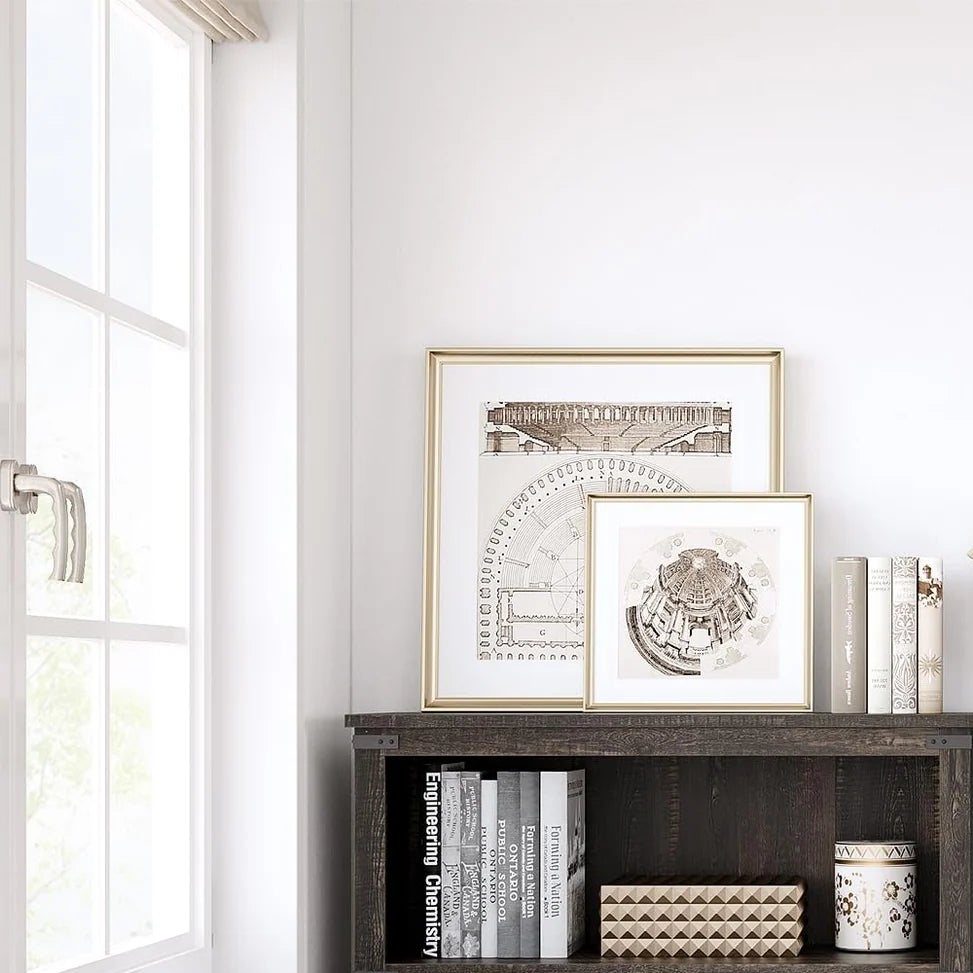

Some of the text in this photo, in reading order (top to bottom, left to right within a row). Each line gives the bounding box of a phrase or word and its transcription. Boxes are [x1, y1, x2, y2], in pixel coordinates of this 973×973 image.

[423, 772, 441, 957] Engineering Chemistry
[498, 819, 506, 923] PUBLIC SCHOOL
[509, 844, 518, 901] ONTARIO
[526, 825, 536, 871] Forming
[549, 825, 562, 871] Forming
[442, 861, 460, 910] ENGLAND
[461, 861, 480, 910] ENGLAND
[527, 883, 536, 918] Nation
[551, 882, 562, 918] Nation
